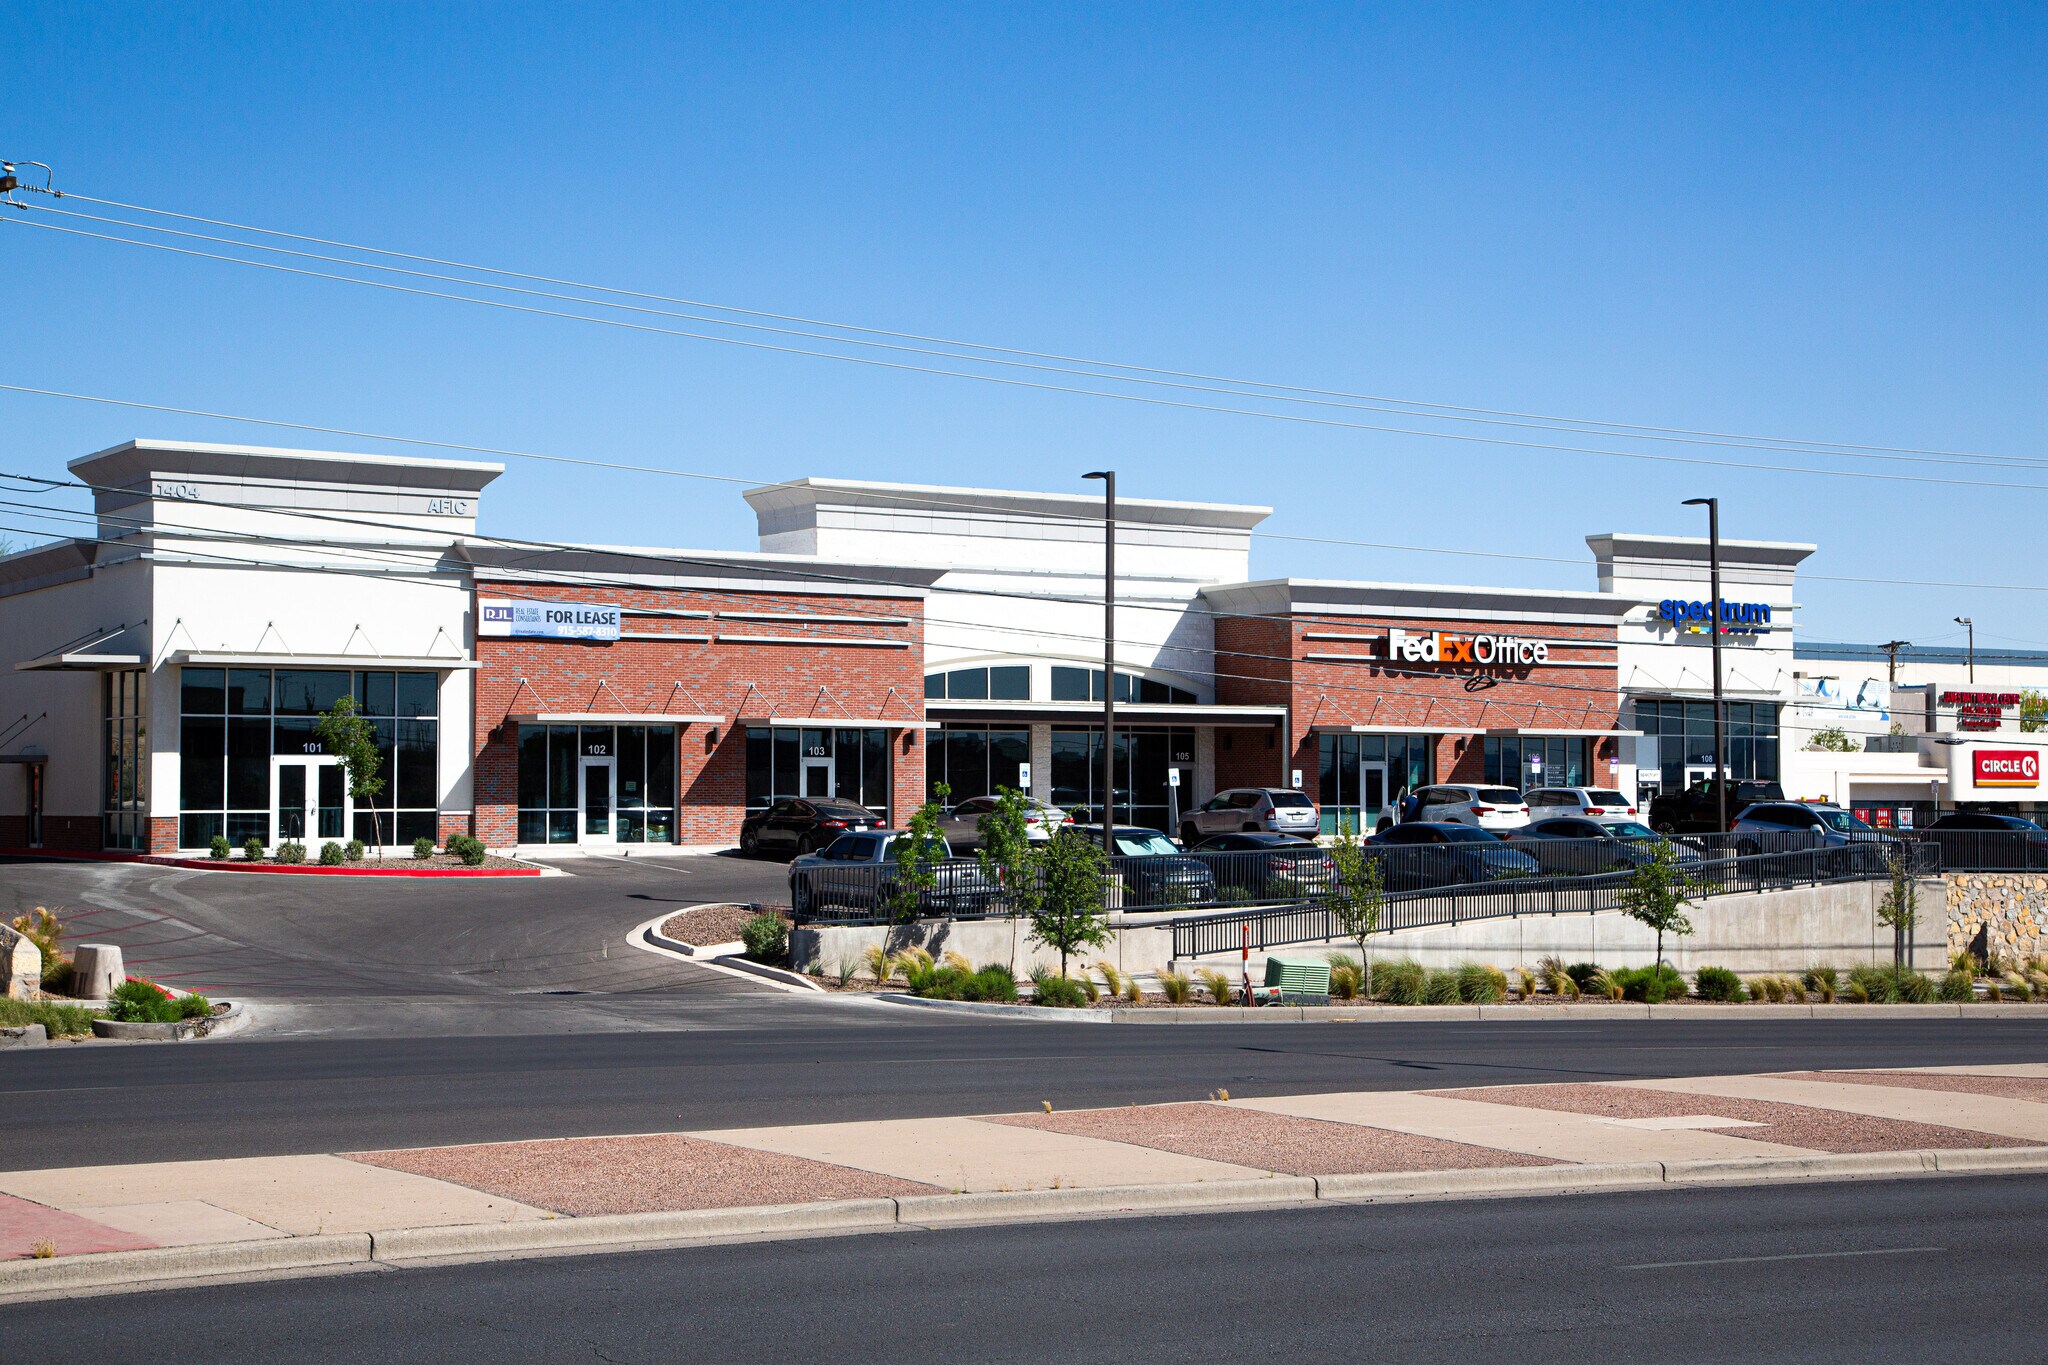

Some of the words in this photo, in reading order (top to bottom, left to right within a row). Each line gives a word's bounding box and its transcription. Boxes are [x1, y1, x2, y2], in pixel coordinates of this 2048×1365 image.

[157, 482, 200, 499] 1404
[427, 498, 467, 515] AFIC
[485, 608, 512, 620] RJL
[546, 610, 573, 624] FOR
[577, 611, 616, 625] LEASE
[1660, 598, 1771, 627] spectrum
[557, 625, 617, 637] 915-587-8310
[1390, 628, 1473, 662] FedEx
[1474, 634, 1549, 665] Office
[302, 742, 322, 753] 101
[588, 744, 607, 755] 102
[808, 746, 826, 756] 103
[1175, 751, 1190, 761] 105
[1701, 755, 1713, 763] 108
[1981, 760, 2021, 773] CIRCLE
[2023, 758, 2035, 775] K
